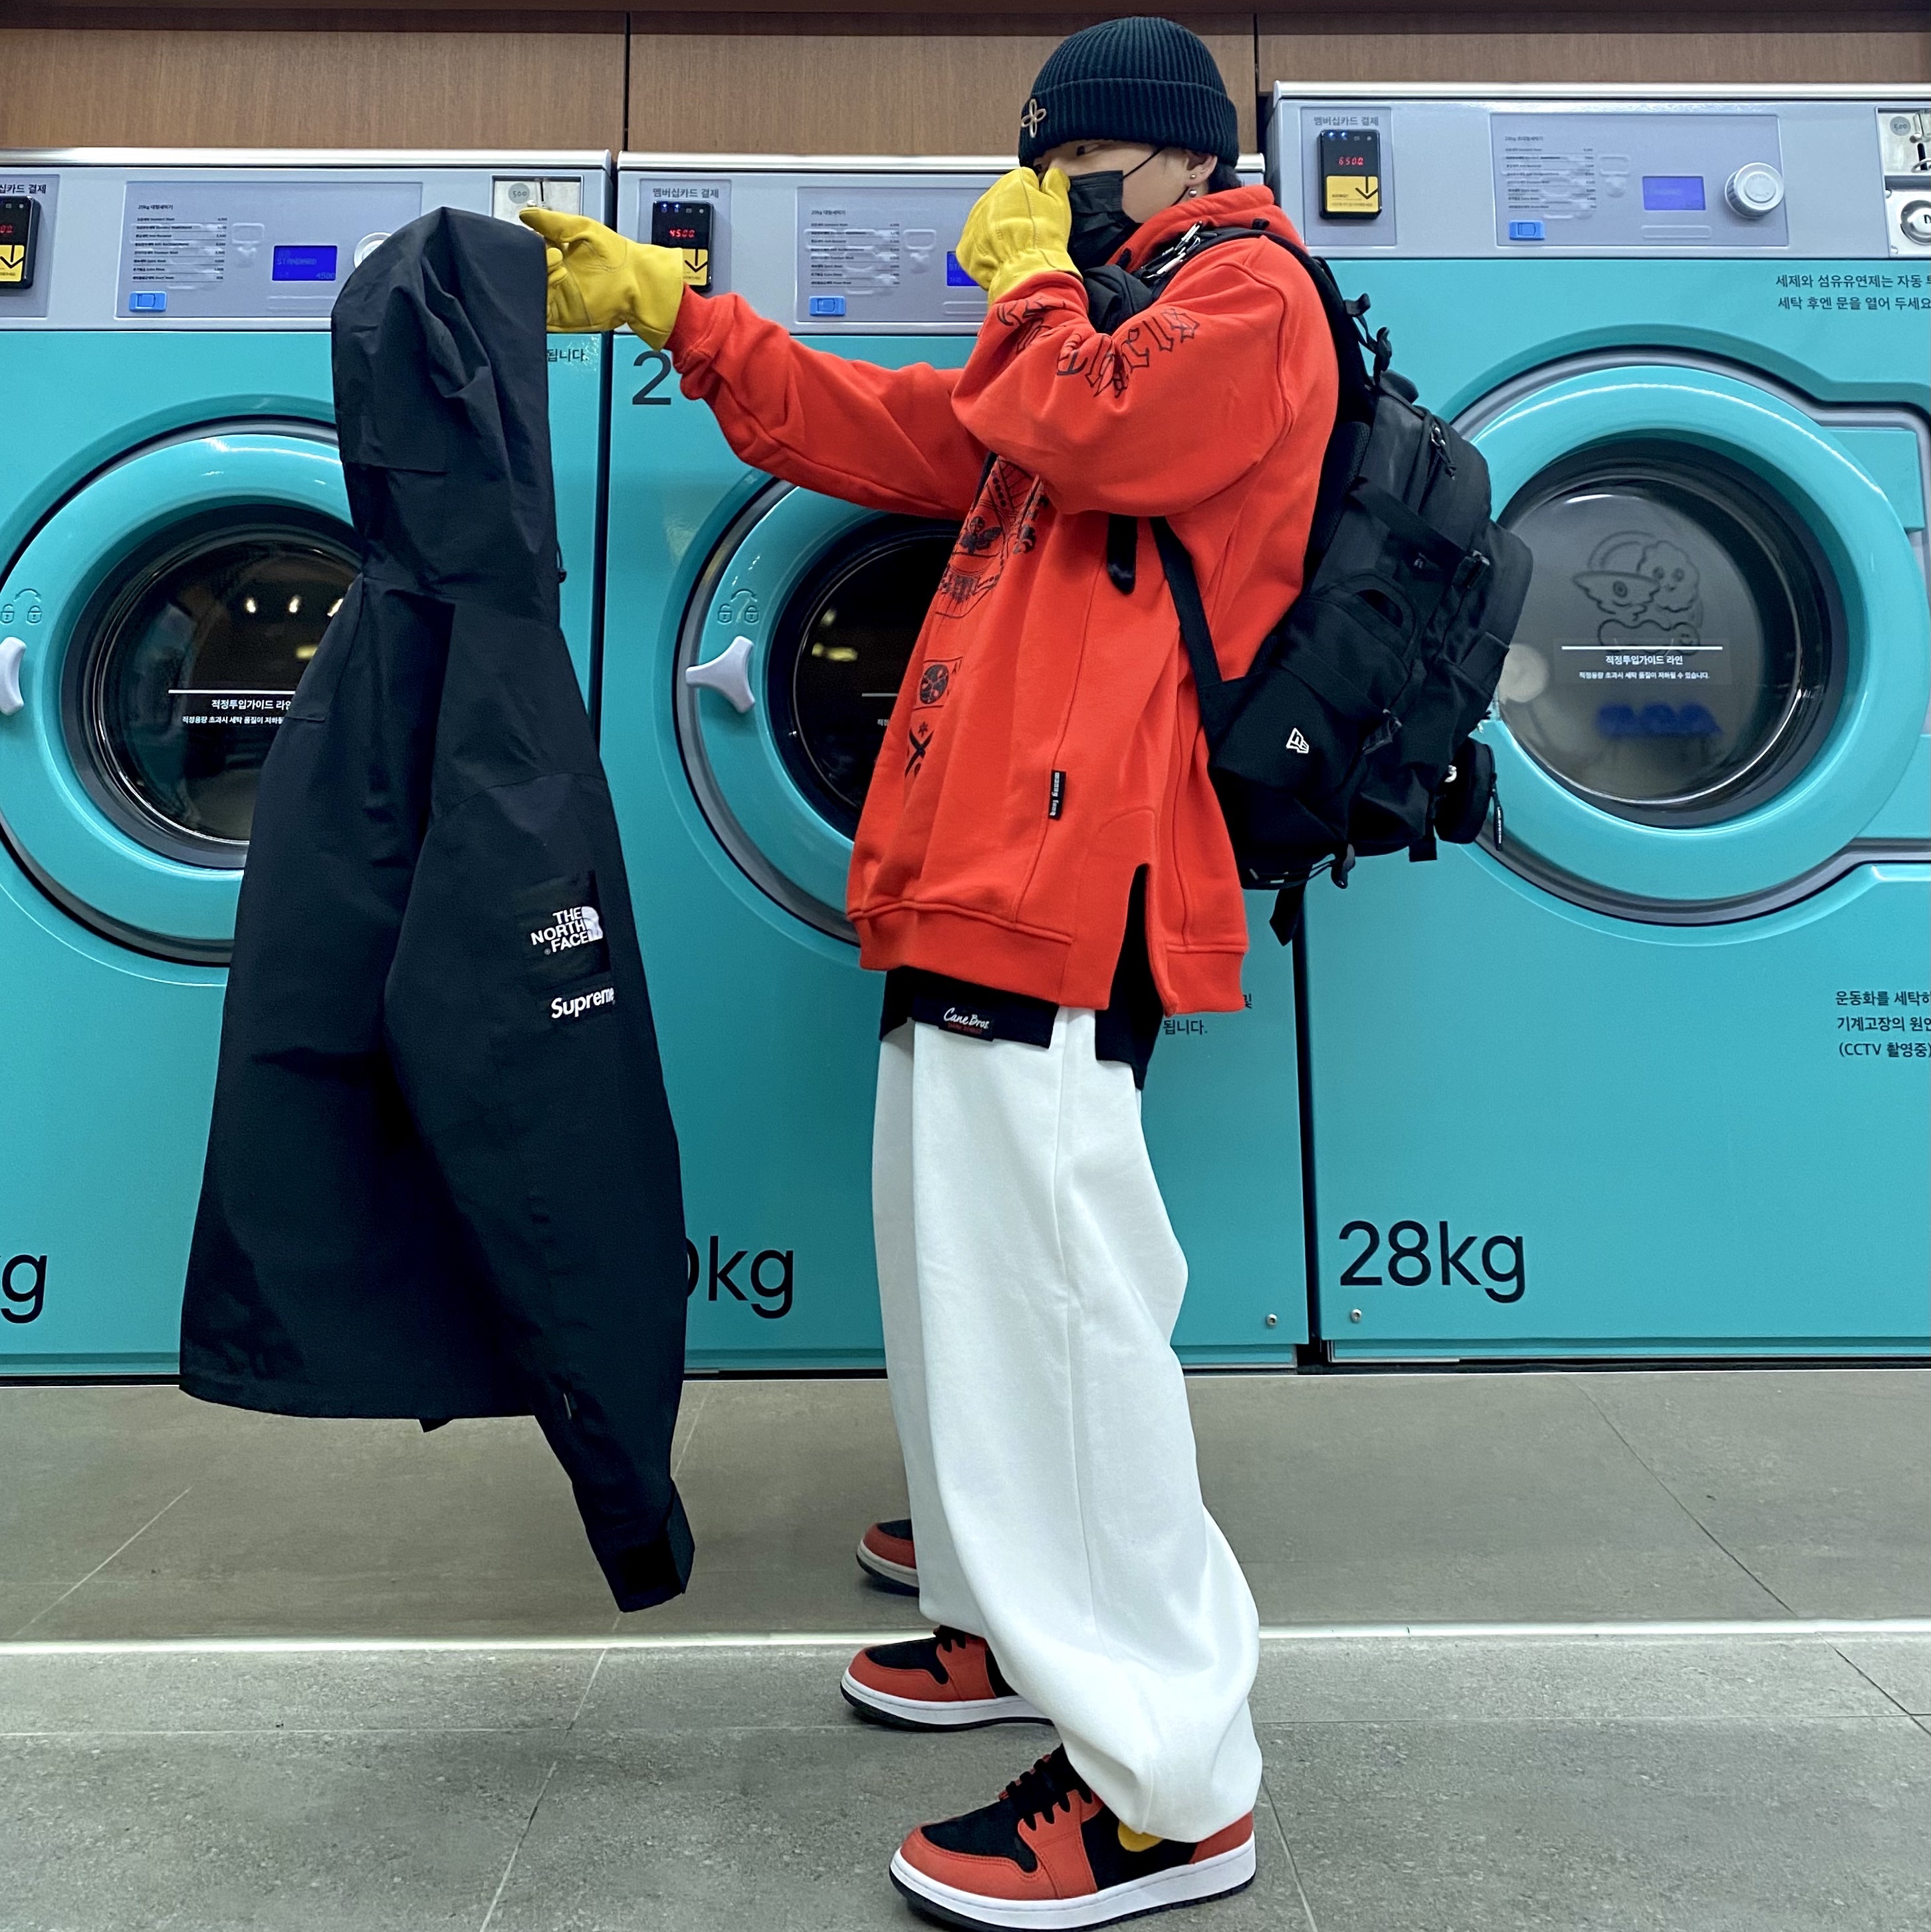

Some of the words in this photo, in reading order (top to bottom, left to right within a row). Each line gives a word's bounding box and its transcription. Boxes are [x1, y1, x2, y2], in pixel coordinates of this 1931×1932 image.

[1314, 116, 1358, 126] 멤버십카드
[1361, 116, 1379, 126] 결제
[1339, 157, 1364, 166] 6500
[29, 183, 47, 193] 결제
[653, 188, 698, 197] 멤버십카드
[701, 188, 719, 198] 결제
[669, 229, 695, 238] 4500
[1776, 275, 1813, 288] 세제와
[1818, 275, 1893, 288] 섬유유연제는
[1897, 275, 1922, 288] 자동
[1778, 297, 1803, 310] 세탁
[1807, 297, 1833, 310] 후엔
[1837, 297, 1861, 310] 문을
[1865, 297, 1890, 310] 열어
[1606, 655, 1664, 665] 적정투입가이드
[1666, 655, 1683, 665] 라인
[211, 699, 274, 709] 적정투입가이드
[552, 907, 582, 924] THE
[530, 918, 586, 945] NORTH
[551, 929, 590, 953] FACE
[1835, 991, 1890, 1006] 운동화를
[944, 1007, 969, 1025] Cane
[1163, 1019, 1208, 1035] 됩니다.
[1837, 1016, 1905, 1032] 기계고장의
[1839, 1042, 1881, 1058] (CCTV
[1339, 1220, 1526, 1303] 28kg
